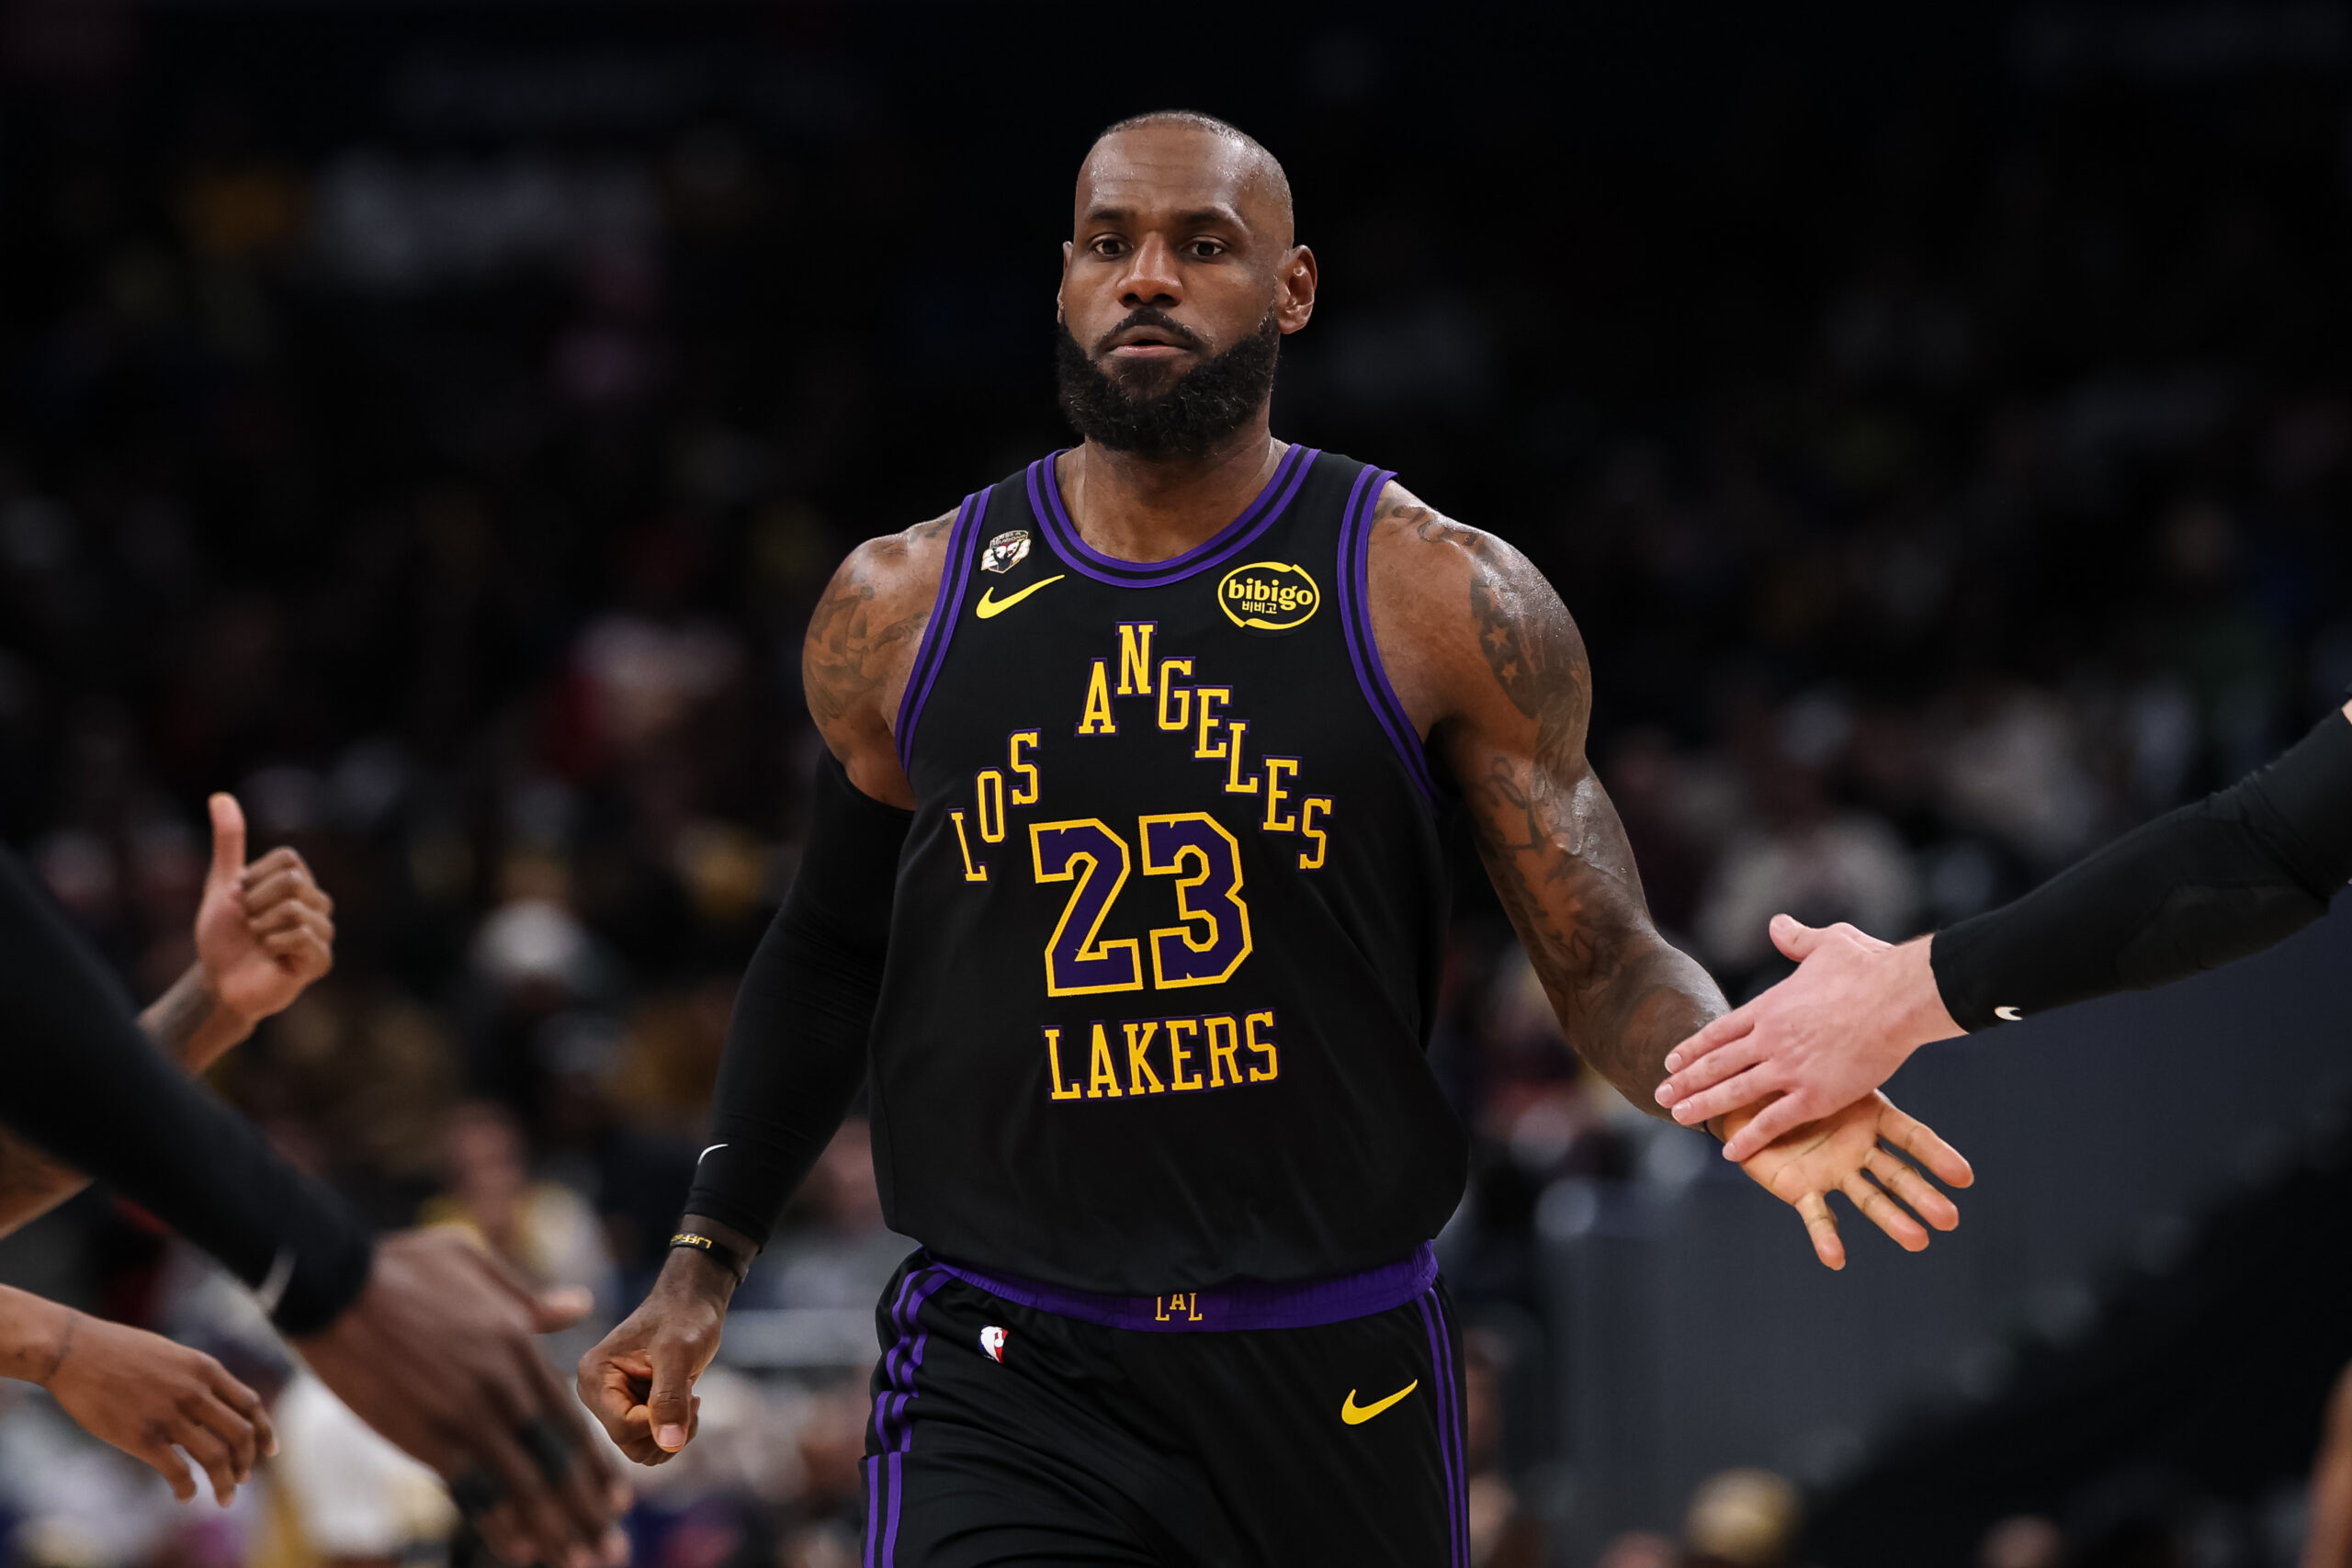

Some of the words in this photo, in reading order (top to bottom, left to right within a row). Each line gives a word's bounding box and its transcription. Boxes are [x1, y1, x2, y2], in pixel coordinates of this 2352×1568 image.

[1227, 578, 1314, 611] bibigo
[1241, 601, 1277, 615] 비비고
[948, 729, 1040, 883] LOS
[1076, 622, 1334, 871] ANGELES
[1029, 812, 1252, 998] 23
[1043, 1010, 1279, 1100] LAKERS
[1155, 1292, 1203, 1321] LAL
